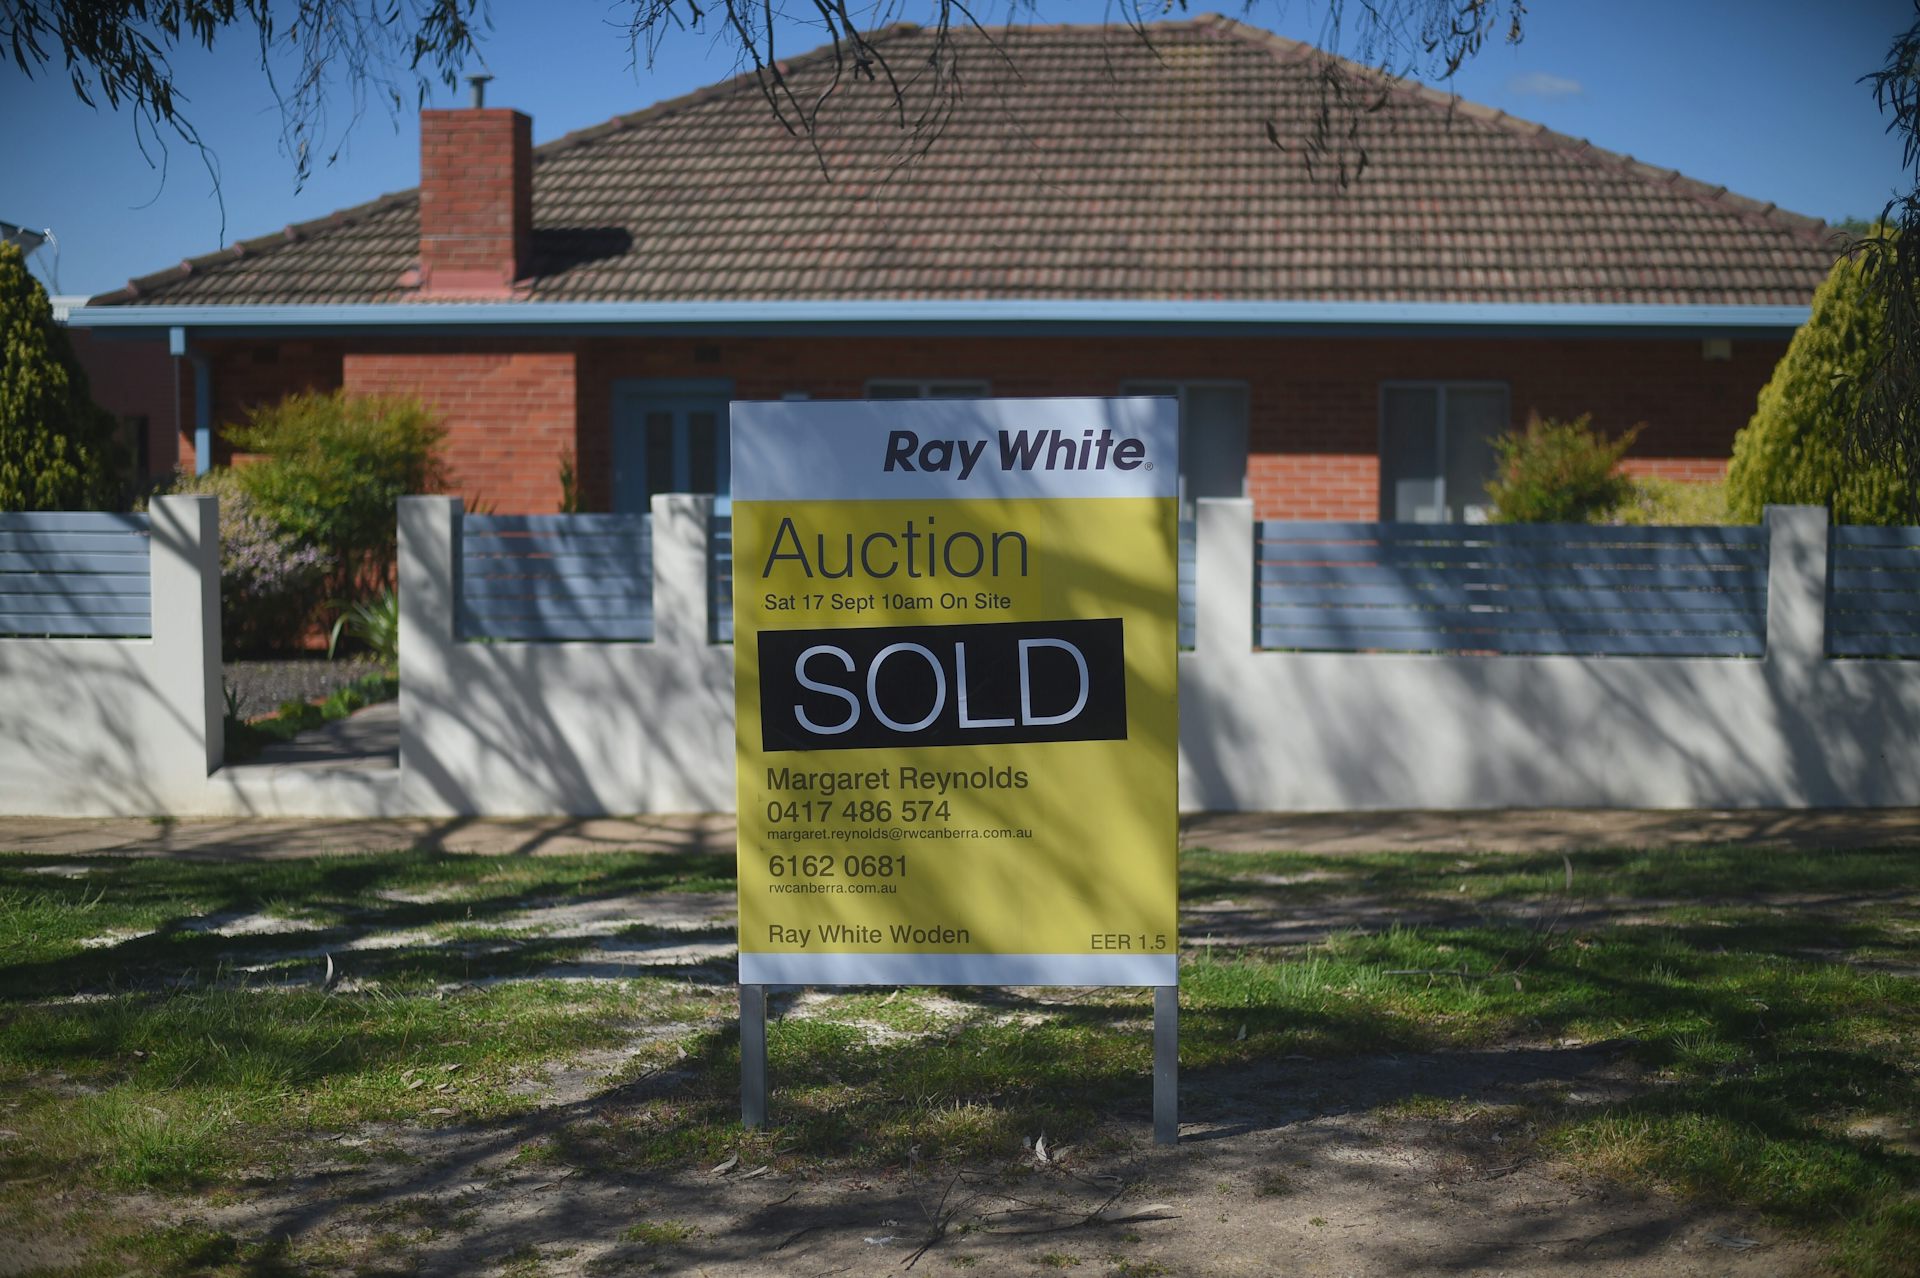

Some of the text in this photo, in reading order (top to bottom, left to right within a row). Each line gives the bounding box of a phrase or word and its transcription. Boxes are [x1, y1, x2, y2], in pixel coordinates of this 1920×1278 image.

[883, 430, 987, 480] Ray
[762, 516, 1028, 578] Auction
[765, 592, 1011, 613] Sat 17 Sept 10am On Site
[793, 637, 1090, 736] SOLD
[767, 766, 1029, 796] Margaret Reynolds
[767, 799, 951, 823] 0417 486 574
[767, 826, 1033, 842] margaret.reynolds@rwcanberra.com.au
[769, 854, 907, 877] 6162 0681
[769, 882, 897, 894] rwcanberra.com.au
[769, 924, 970, 947] Ray White Woden
[1091, 934, 1166, 950] EER 1.5
